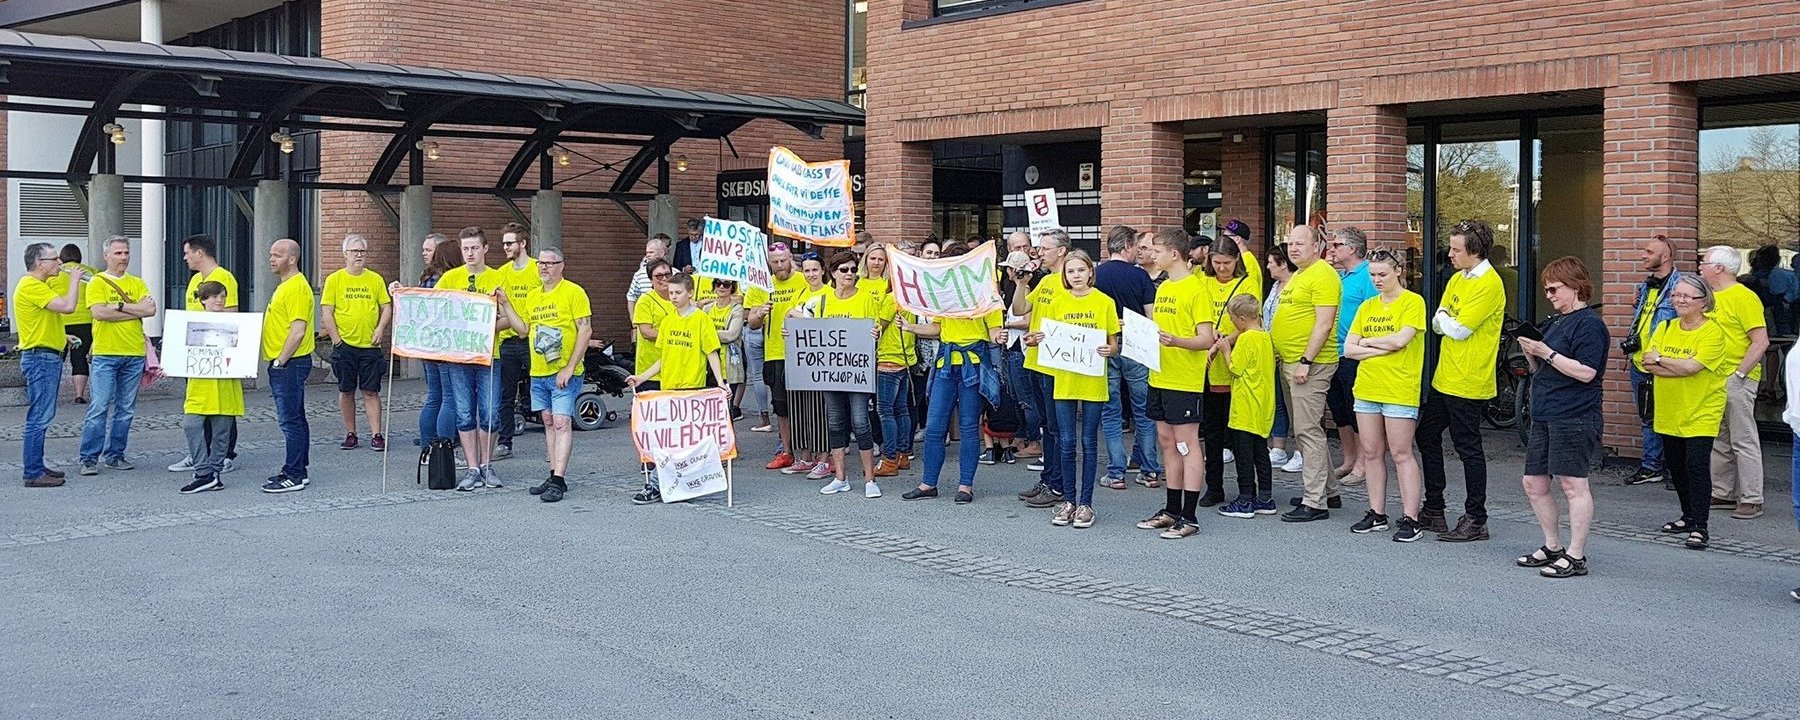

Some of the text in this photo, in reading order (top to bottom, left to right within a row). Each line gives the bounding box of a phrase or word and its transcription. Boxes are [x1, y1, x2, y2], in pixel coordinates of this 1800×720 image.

[721, 180, 769, 198] SKEDSM
[810, 187, 841, 199] DETTE
[727, 224, 752, 246] OSS
[703, 237, 743, 260] NAV?
[701, 259, 738, 277] GANG
[453, 328, 489, 353] VEKK
[795, 329, 848, 348] HELSE
[797, 351, 870, 368] FØR PENGER
[811, 371, 868, 385] UTKJØP NÅ
[640, 400, 667, 422] VIL
[670, 399, 688, 422] DU
[635, 421, 727, 451] VI VIL FLYTTE
